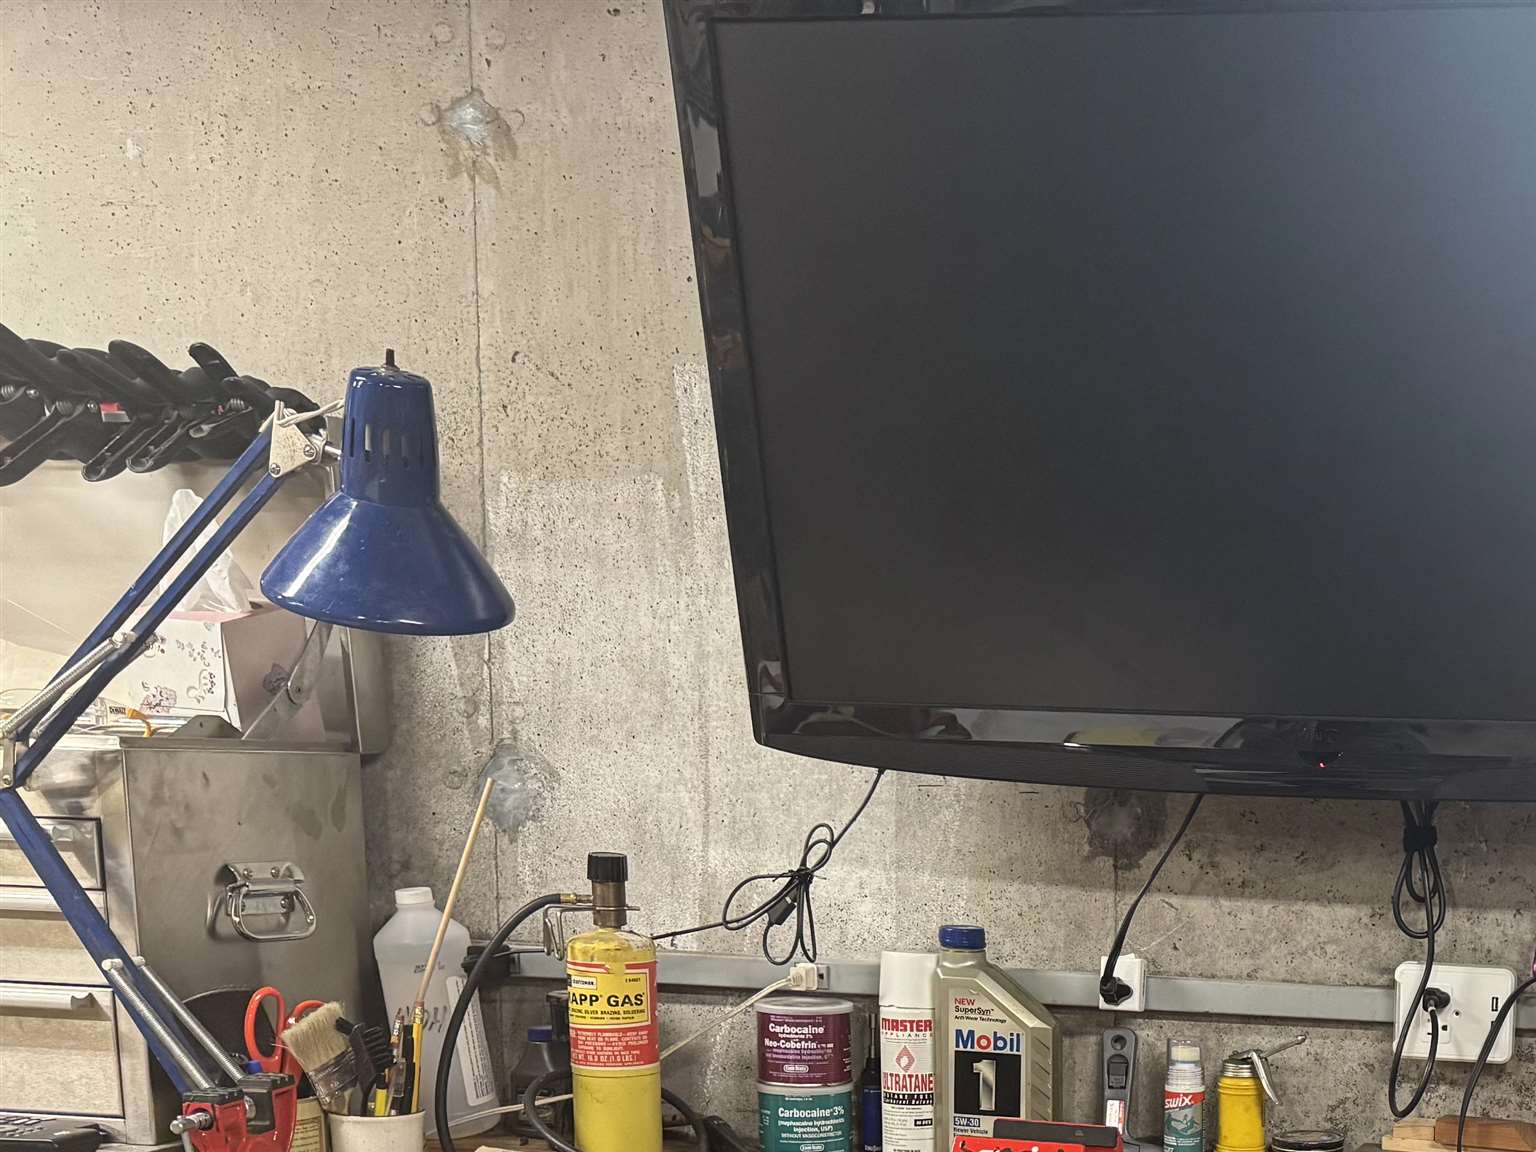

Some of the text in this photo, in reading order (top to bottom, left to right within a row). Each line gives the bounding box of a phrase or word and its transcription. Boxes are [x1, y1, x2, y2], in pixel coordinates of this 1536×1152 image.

[569, 991, 644, 1008] APP GAS
[955, 998, 976, 1006] NEW
[769, 1023, 824, 1034] Carbocaine
[881, 1018, 933, 1032] MASTER
[955, 1029, 1021, 1052] Mobil
[882, 1072, 934, 1092] ULTRATANE
[973, 1060, 996, 1111] 1
[1164, 1094, 1195, 1109] swix
[778, 1105, 845, 1118] Carbocaine 3%
[954, 1117, 980, 1127] 5W-30
